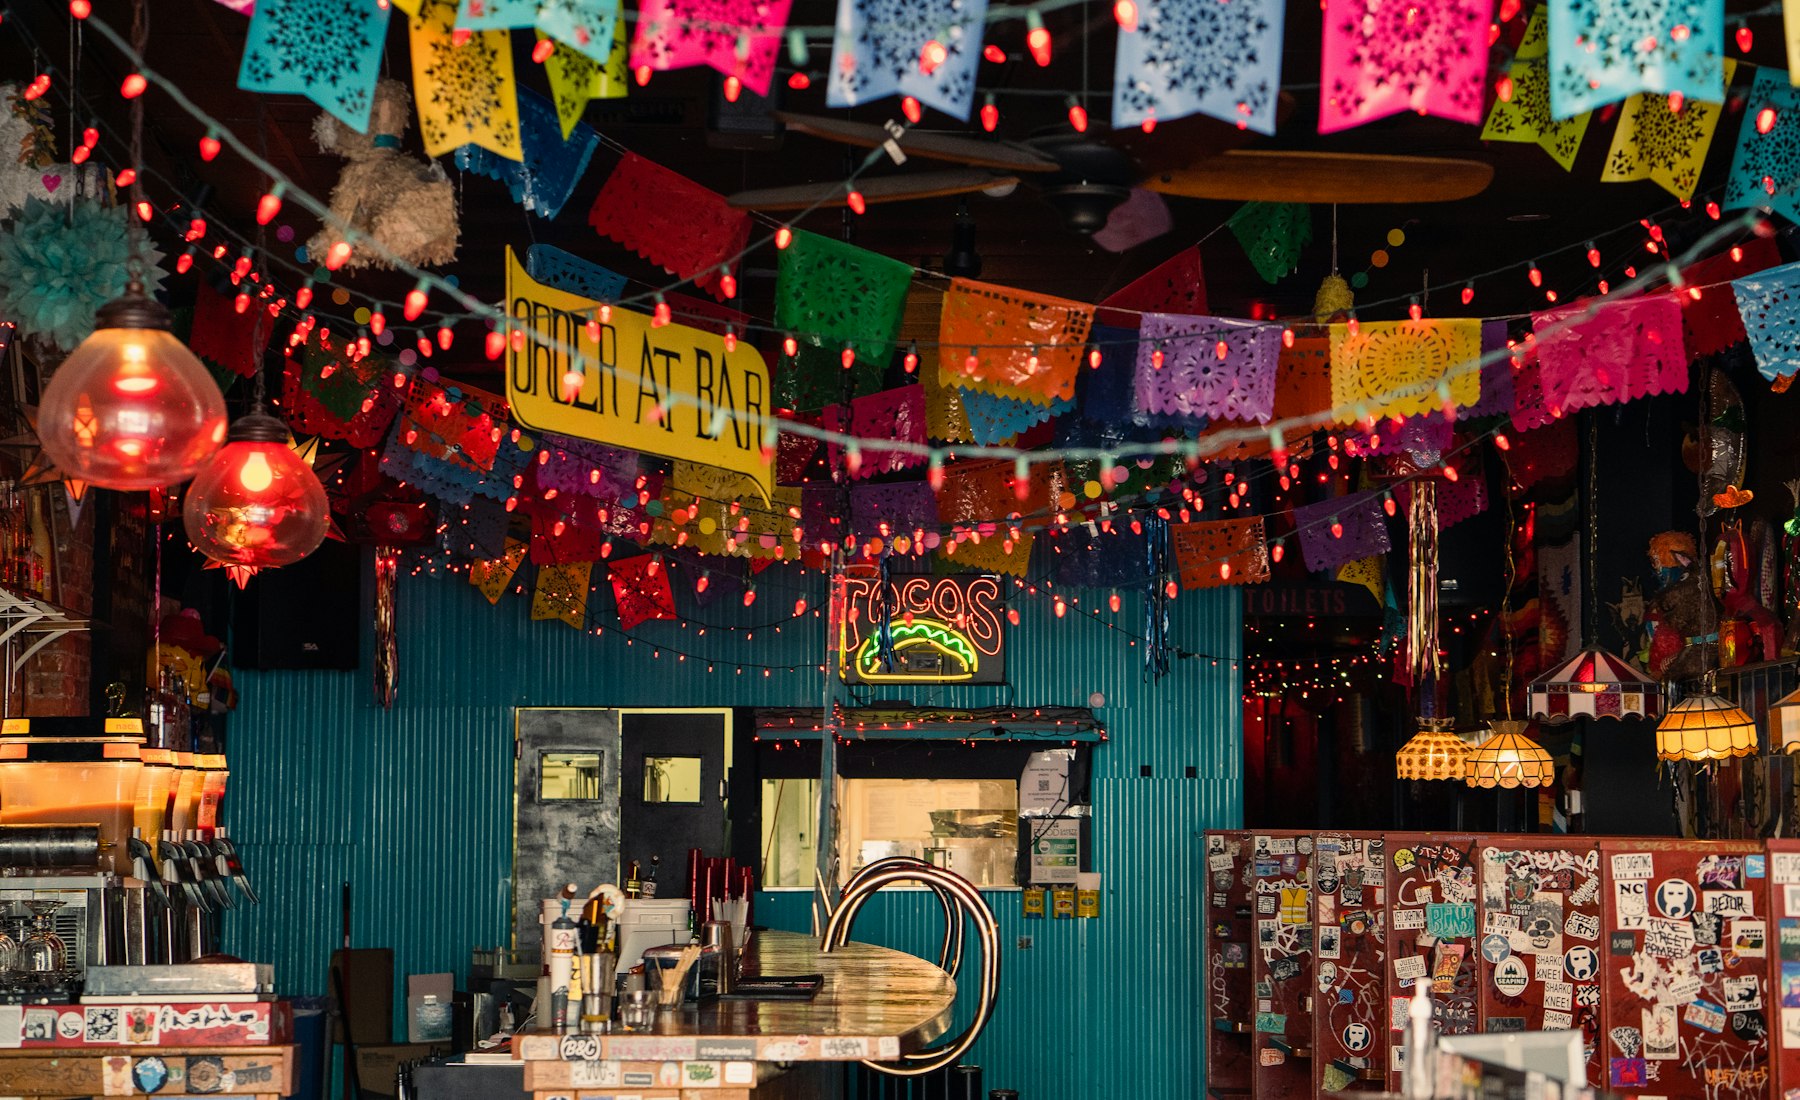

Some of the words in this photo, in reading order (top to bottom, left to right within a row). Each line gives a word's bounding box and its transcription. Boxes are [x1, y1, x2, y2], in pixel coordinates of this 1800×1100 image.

[513, 297, 619, 417] ORDER
[634, 330, 681, 433] AT
[694, 346, 766, 456] BAR
[1245, 589, 1345, 614] TOILETS
[841, 578, 1002, 656] TACOS
[1034, 829, 1059, 837] FOOD
[1614, 856, 1625, 869] YETI
[1626, 855, 1652, 869] SIGHTING
[1619, 883, 1645, 895] NC
[1510, 903, 1531, 911] LOCUST
[1622, 916, 1644, 927] 17
[1650, 919, 1689, 933] PINE
[1645, 931, 1692, 948] STREET
[1536, 954, 1563, 966] SHARKO
[1497, 978, 1525, 986] SEAPINE
[1545, 982, 1572, 995] SHARKO
[1544, 1011, 1572, 1026] SHARKO
[564, 1039, 597, 1058] B&C
